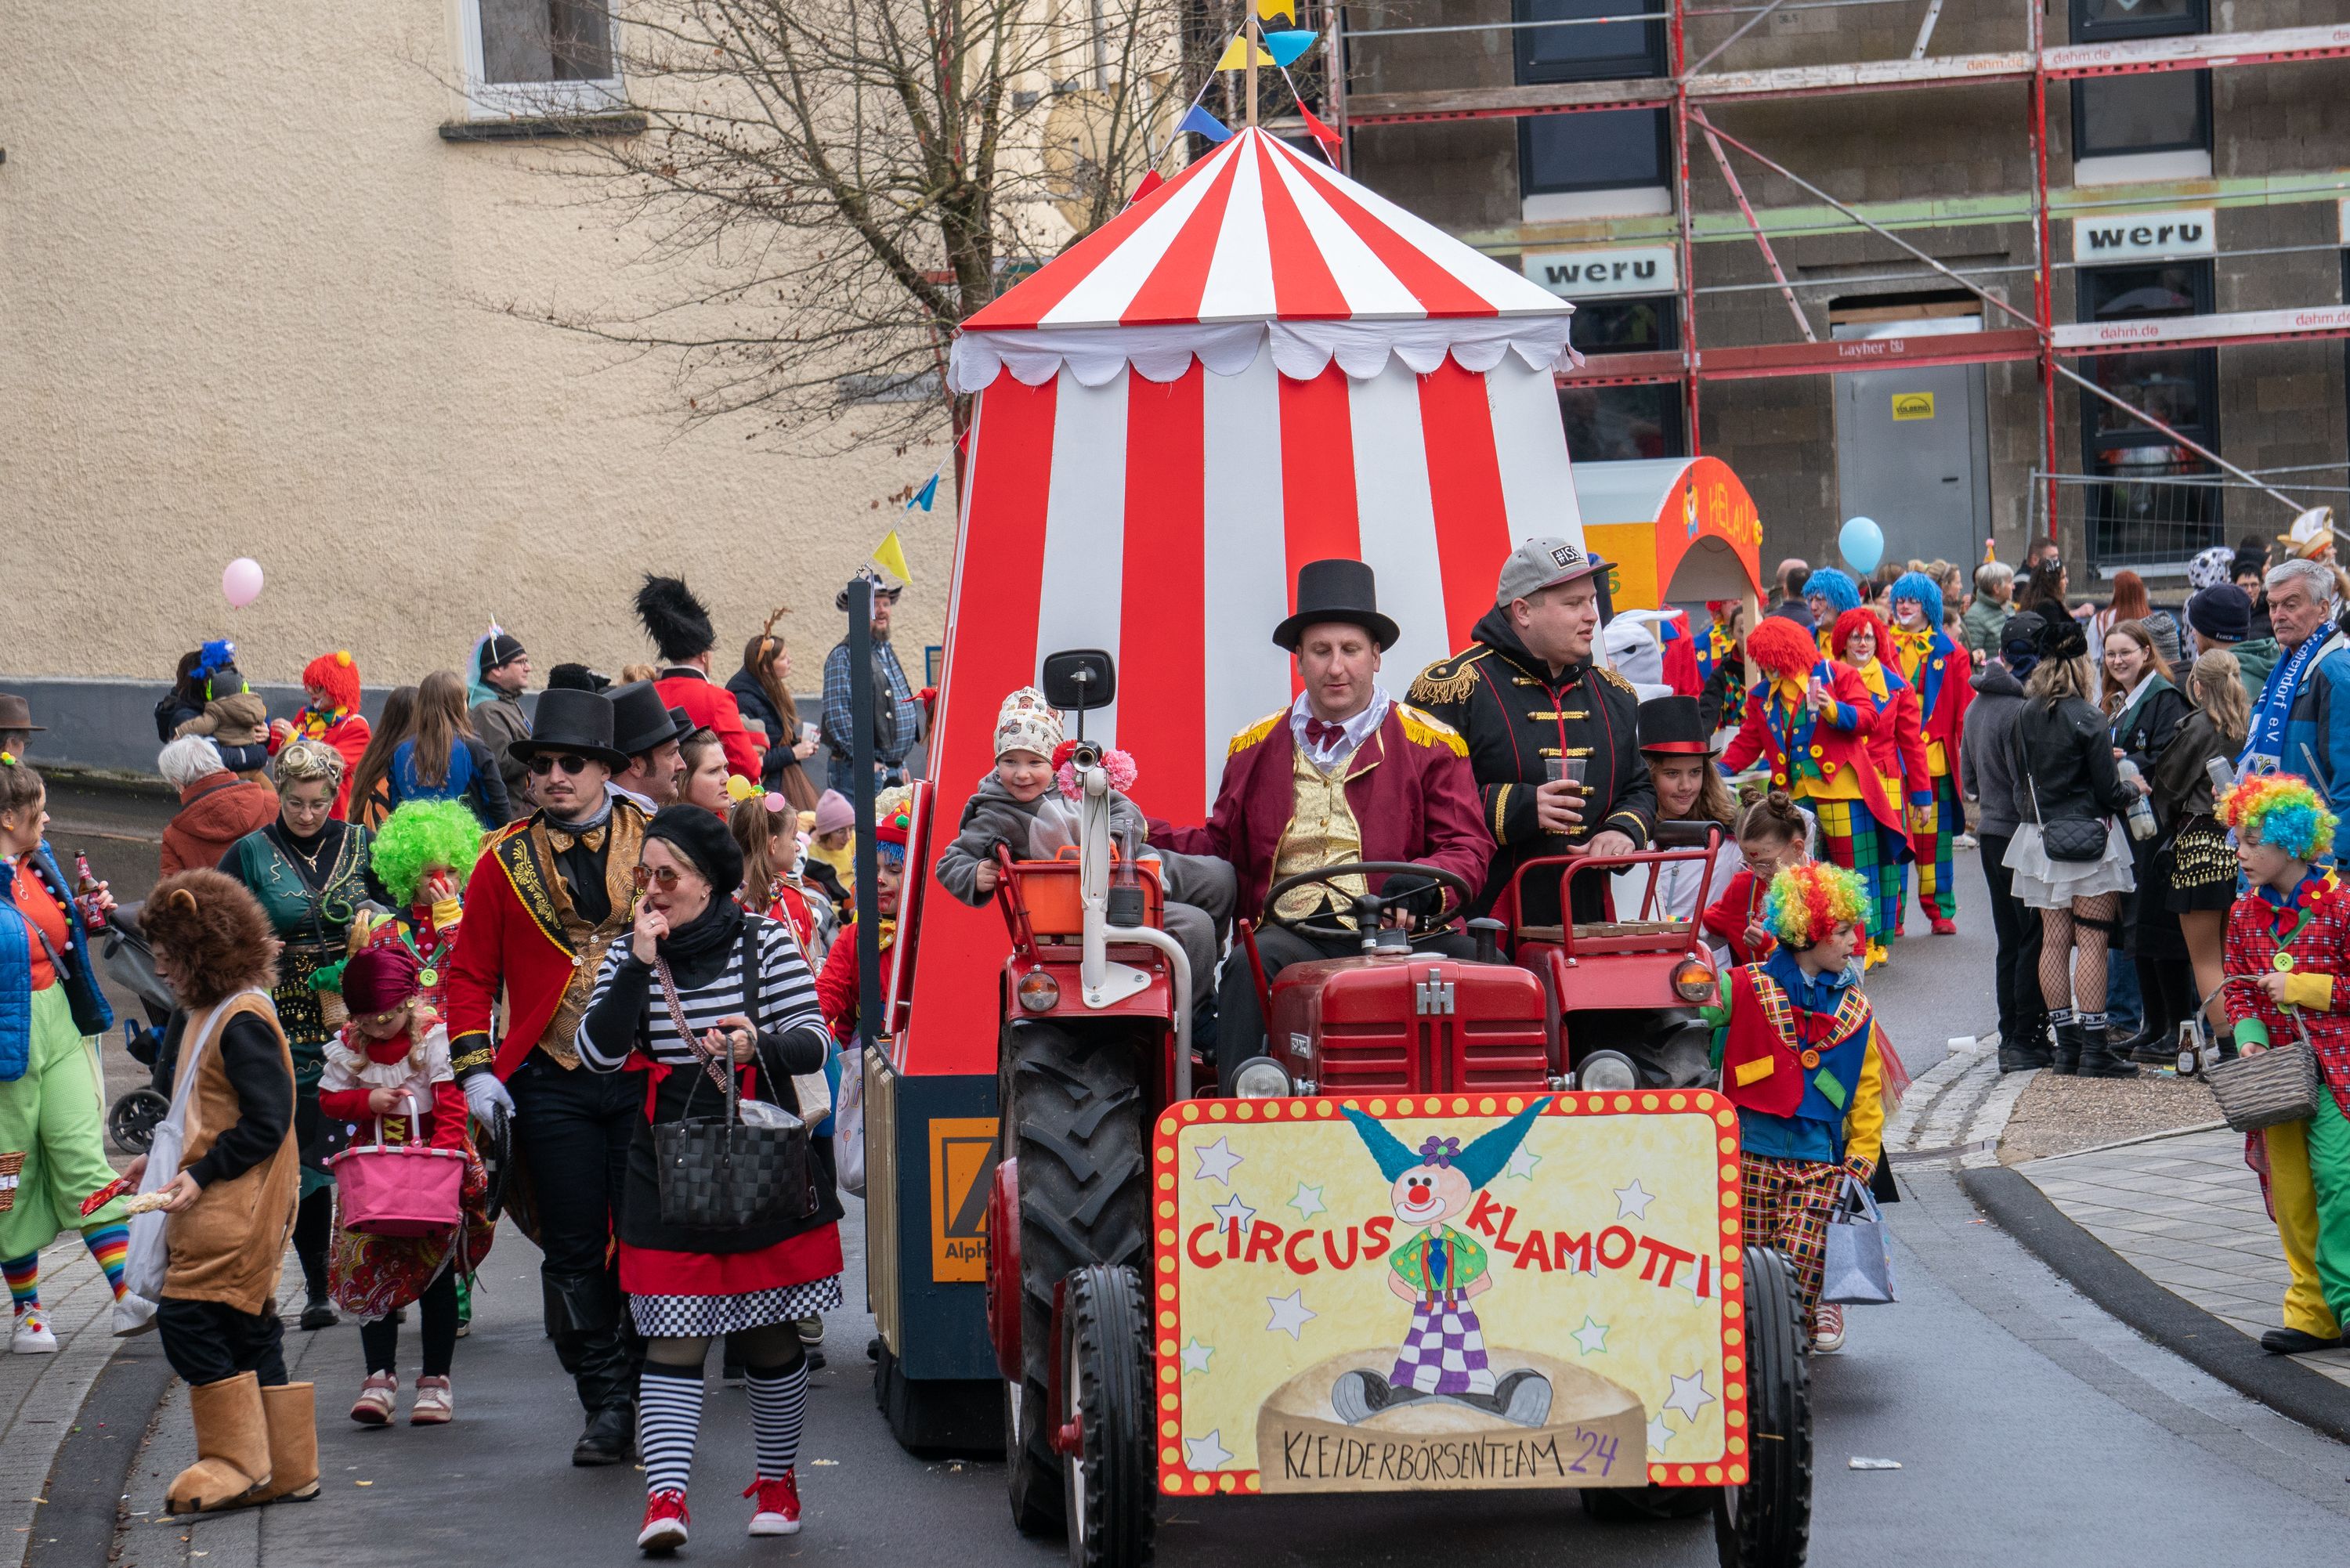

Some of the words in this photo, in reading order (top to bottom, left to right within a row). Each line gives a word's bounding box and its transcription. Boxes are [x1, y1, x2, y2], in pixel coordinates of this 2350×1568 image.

[1967, 56, 2025, 72] dahm.de
[2052, 49, 2111, 64] dahm.de
[2088, 220, 2203, 249] weru
[1545, 258, 1657, 284] weru
[2100, 324, 2160, 340] dahm.de
[1838, 341, 1885, 357] Layher
[1708, 482, 1749, 545] HELAU
[2265, 717, 2280, 742] e.V.
[1187, 1216, 1394, 1276] CIRCUS
[1465, 1189, 1711, 1298] KLAMOTTI
[1283, 1432, 1566, 1482] KLEIDERBÖRSENTEAM
[1568, 1425, 1619, 1476] '24
